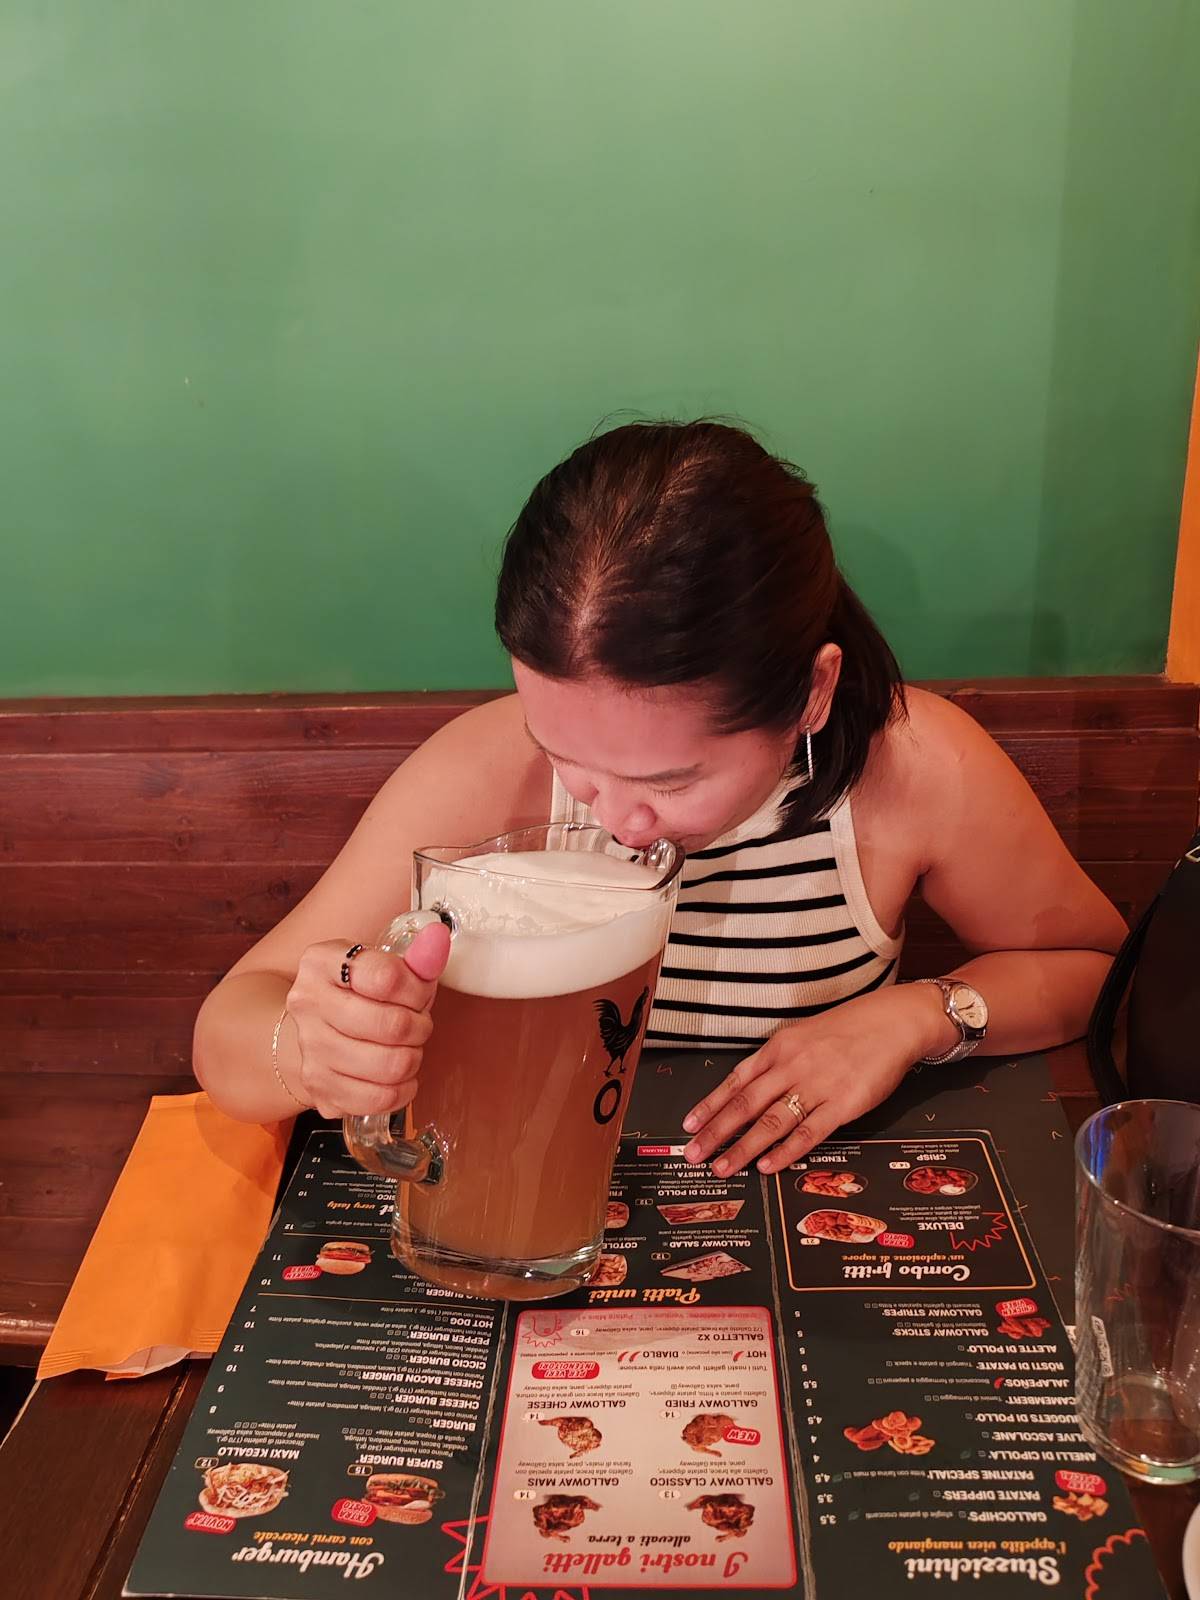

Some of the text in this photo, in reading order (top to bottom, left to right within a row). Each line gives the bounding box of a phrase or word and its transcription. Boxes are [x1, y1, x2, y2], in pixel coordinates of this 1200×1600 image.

[916, 1153, 946, 1161] CRISP
[328, 1201, 375, 1210] very tasty
[918, 1222, 964, 1230] DELUXE
[670, 1240, 699, 1248] SALAD
[842, 1253, 876, 1261] sapore
[880, 1254, 890, 1262] di
[842, 1262, 970, 1282] Combo fritti
[589, 1288, 700, 1304] Piatti unici
[928, 1308, 982, 1316] GALLOWAY
[244, 1320, 256, 1328] 10
[450, 1318, 493, 1328] HOT DOG
[934, 1328, 988, 1336] GALLOWAY
[451, 1333, 490, 1345] PEPPER
[714, 1333, 764, 1341] GALLETTO
[234, 1344, 244, 1352] 12
[1006, 1344, 1017, 1353] DI
[1018, 1344, 1057, 1353] ALETTE
[642, 1350, 679, 1358] DIABLO
[746, 1350, 767, 1358] HOT
[226, 1364, 238, 1372] 10
[451, 1358, 486, 1370] CICCIO
[1018, 1362, 1029, 1370] DI
[1032, 1362, 1064, 1371] RÖSTI
[544, 1370, 587, 1378] PER VERI
[405, 1374, 442, 1385] BACON
[443, 1376, 483, 1388] CHEESE
[803, 1380, 817, 1388] 5,5
[439, 1398, 480, 1410] CHEESE
[527, 1400, 626, 1409] GALLOWAY CHEESE
[665, 1400, 758, 1408] GALLOWAY FRIED
[806, 1398, 812, 1406] 5
[808, 1415, 822, 1424] 4,5
[1016, 1414, 1028, 1422] DI
[728, 1429, 756, 1442] NEW
[810, 1434, 817, 1443] 4
[218, 1446, 299, 1460] MAXI KEGALLO
[1042, 1452, 1054, 1460] DI
[1056, 1452, 1096, 1461] ANELLI
[813, 1454, 820, 1462] 4
[406, 1457, 443, 1469] SUPER
[355, 1466, 366, 1474] 15
[815, 1472, 830, 1482] 4,5
[980, 1470, 1034, 1480] PATATINE
[528, 1478, 619, 1486] GALLOWAY MAIS
[650, 1477, 773, 1486] GALLOWAY CLASSICO
[664, 1490, 675, 1498] 13
[818, 1492, 833, 1503] 3,5
[998, 1490, 1040, 1500] PATATE
[342, 1500, 372, 1513] GUSTO
[338, 1509, 369, 1523] EXTRA
[900, 1510, 922, 1518] patate
[922, 1511, 929, 1519] di
[820, 1514, 836, 1524] 3,5
[253, 1530, 373, 1546] con carni ricercate
[588, 1535, 691, 1547] allevati a terra
[888, 1538, 1066, 1555] l'appetito vien mangiando
[232, 1541, 384, 1579] Hamburger
[543, 1547, 748, 1578] I nostri galletti
[904, 1556, 1060, 1585] Stuzzichini
